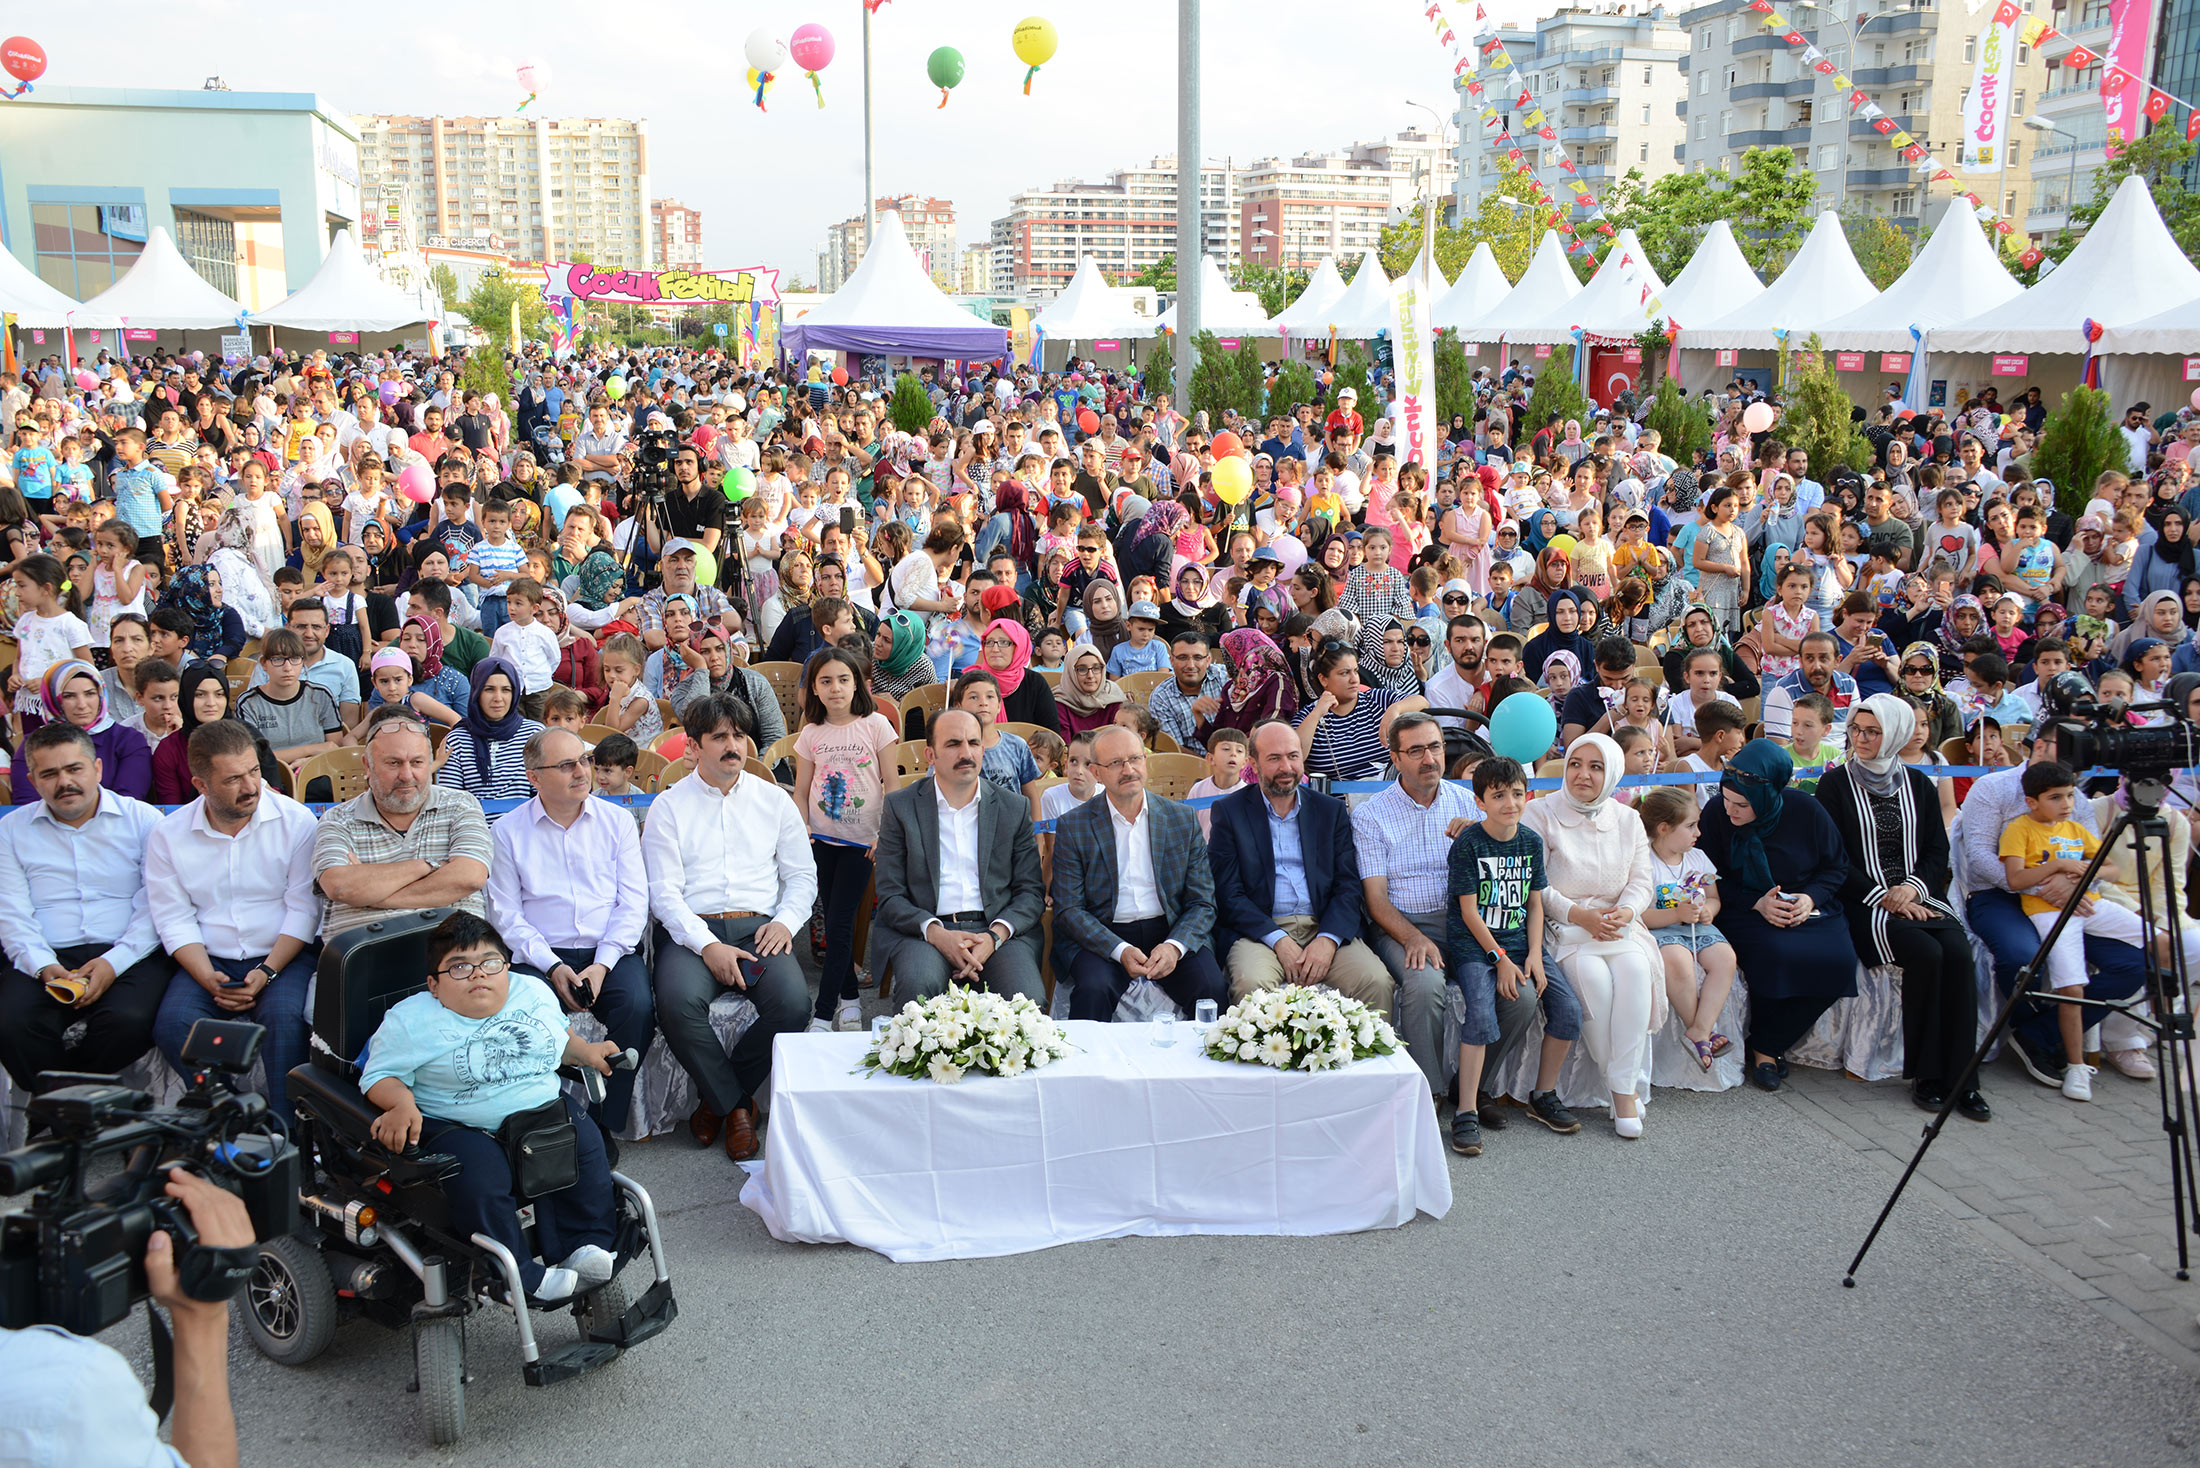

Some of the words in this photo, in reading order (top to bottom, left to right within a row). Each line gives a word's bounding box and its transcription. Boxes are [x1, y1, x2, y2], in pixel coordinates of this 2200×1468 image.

[593, 264, 624, 276] Konya
[567, 263, 663, 301] Çocuk
[656, 271, 756, 303] Festivali
[1579, 573, 1606, 587] POWER
[816, 743, 864, 756] Eternity
[1498, 855, 1533, 868] DON'T
[1498, 867, 1533, 880] PANIC
[1478, 880, 1532, 908] SHARK
